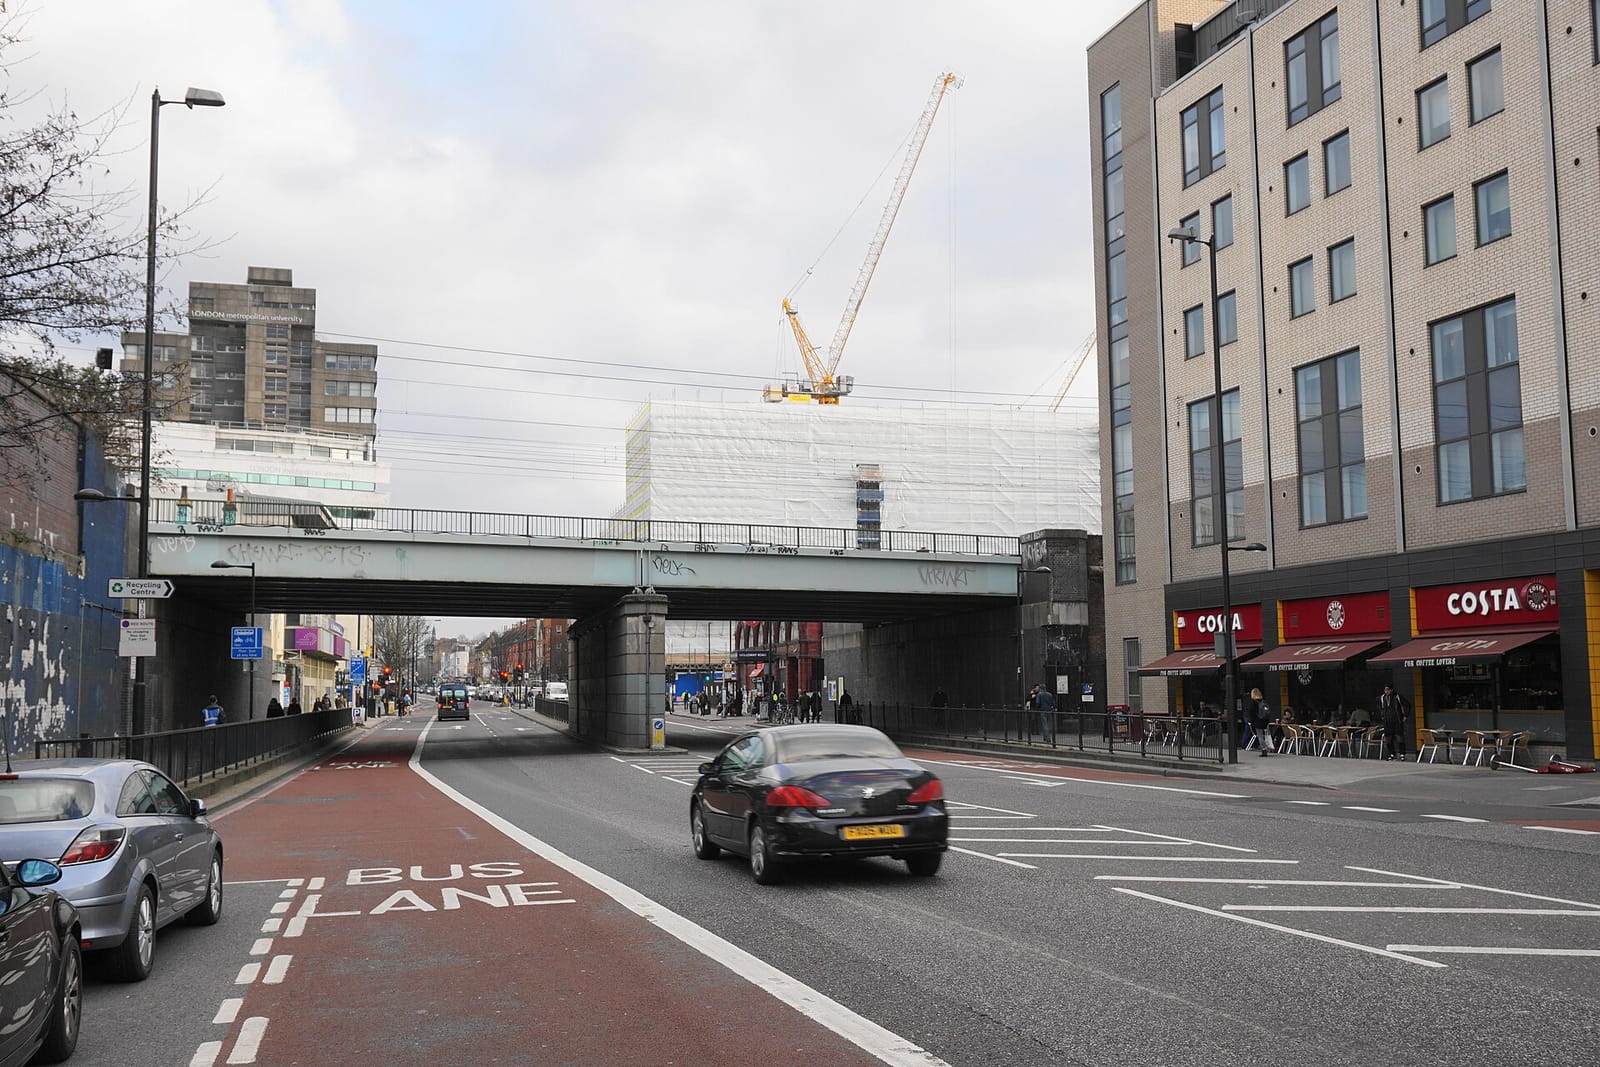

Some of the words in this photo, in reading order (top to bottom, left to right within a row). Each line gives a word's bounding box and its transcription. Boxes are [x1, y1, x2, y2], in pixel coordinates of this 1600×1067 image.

[191, 310, 225, 318] LONDON
[226, 313, 269, 321] metropolitan
[270, 316, 303, 325] university
[1529, 584, 1545, 593] COSTA
[1447, 588, 1521, 616] COSTA
[1528, 599, 1548, 609] COFFEE
[1197, 613, 1242, 633] COSA
[1430, 639, 1499, 651] COSTA
[1416, 659, 1435, 667] COFFEE
[1436, 658, 1456, 666] LOVERS
[346, 862, 525, 886] BUS
[297, 881, 577, 918] LANE
